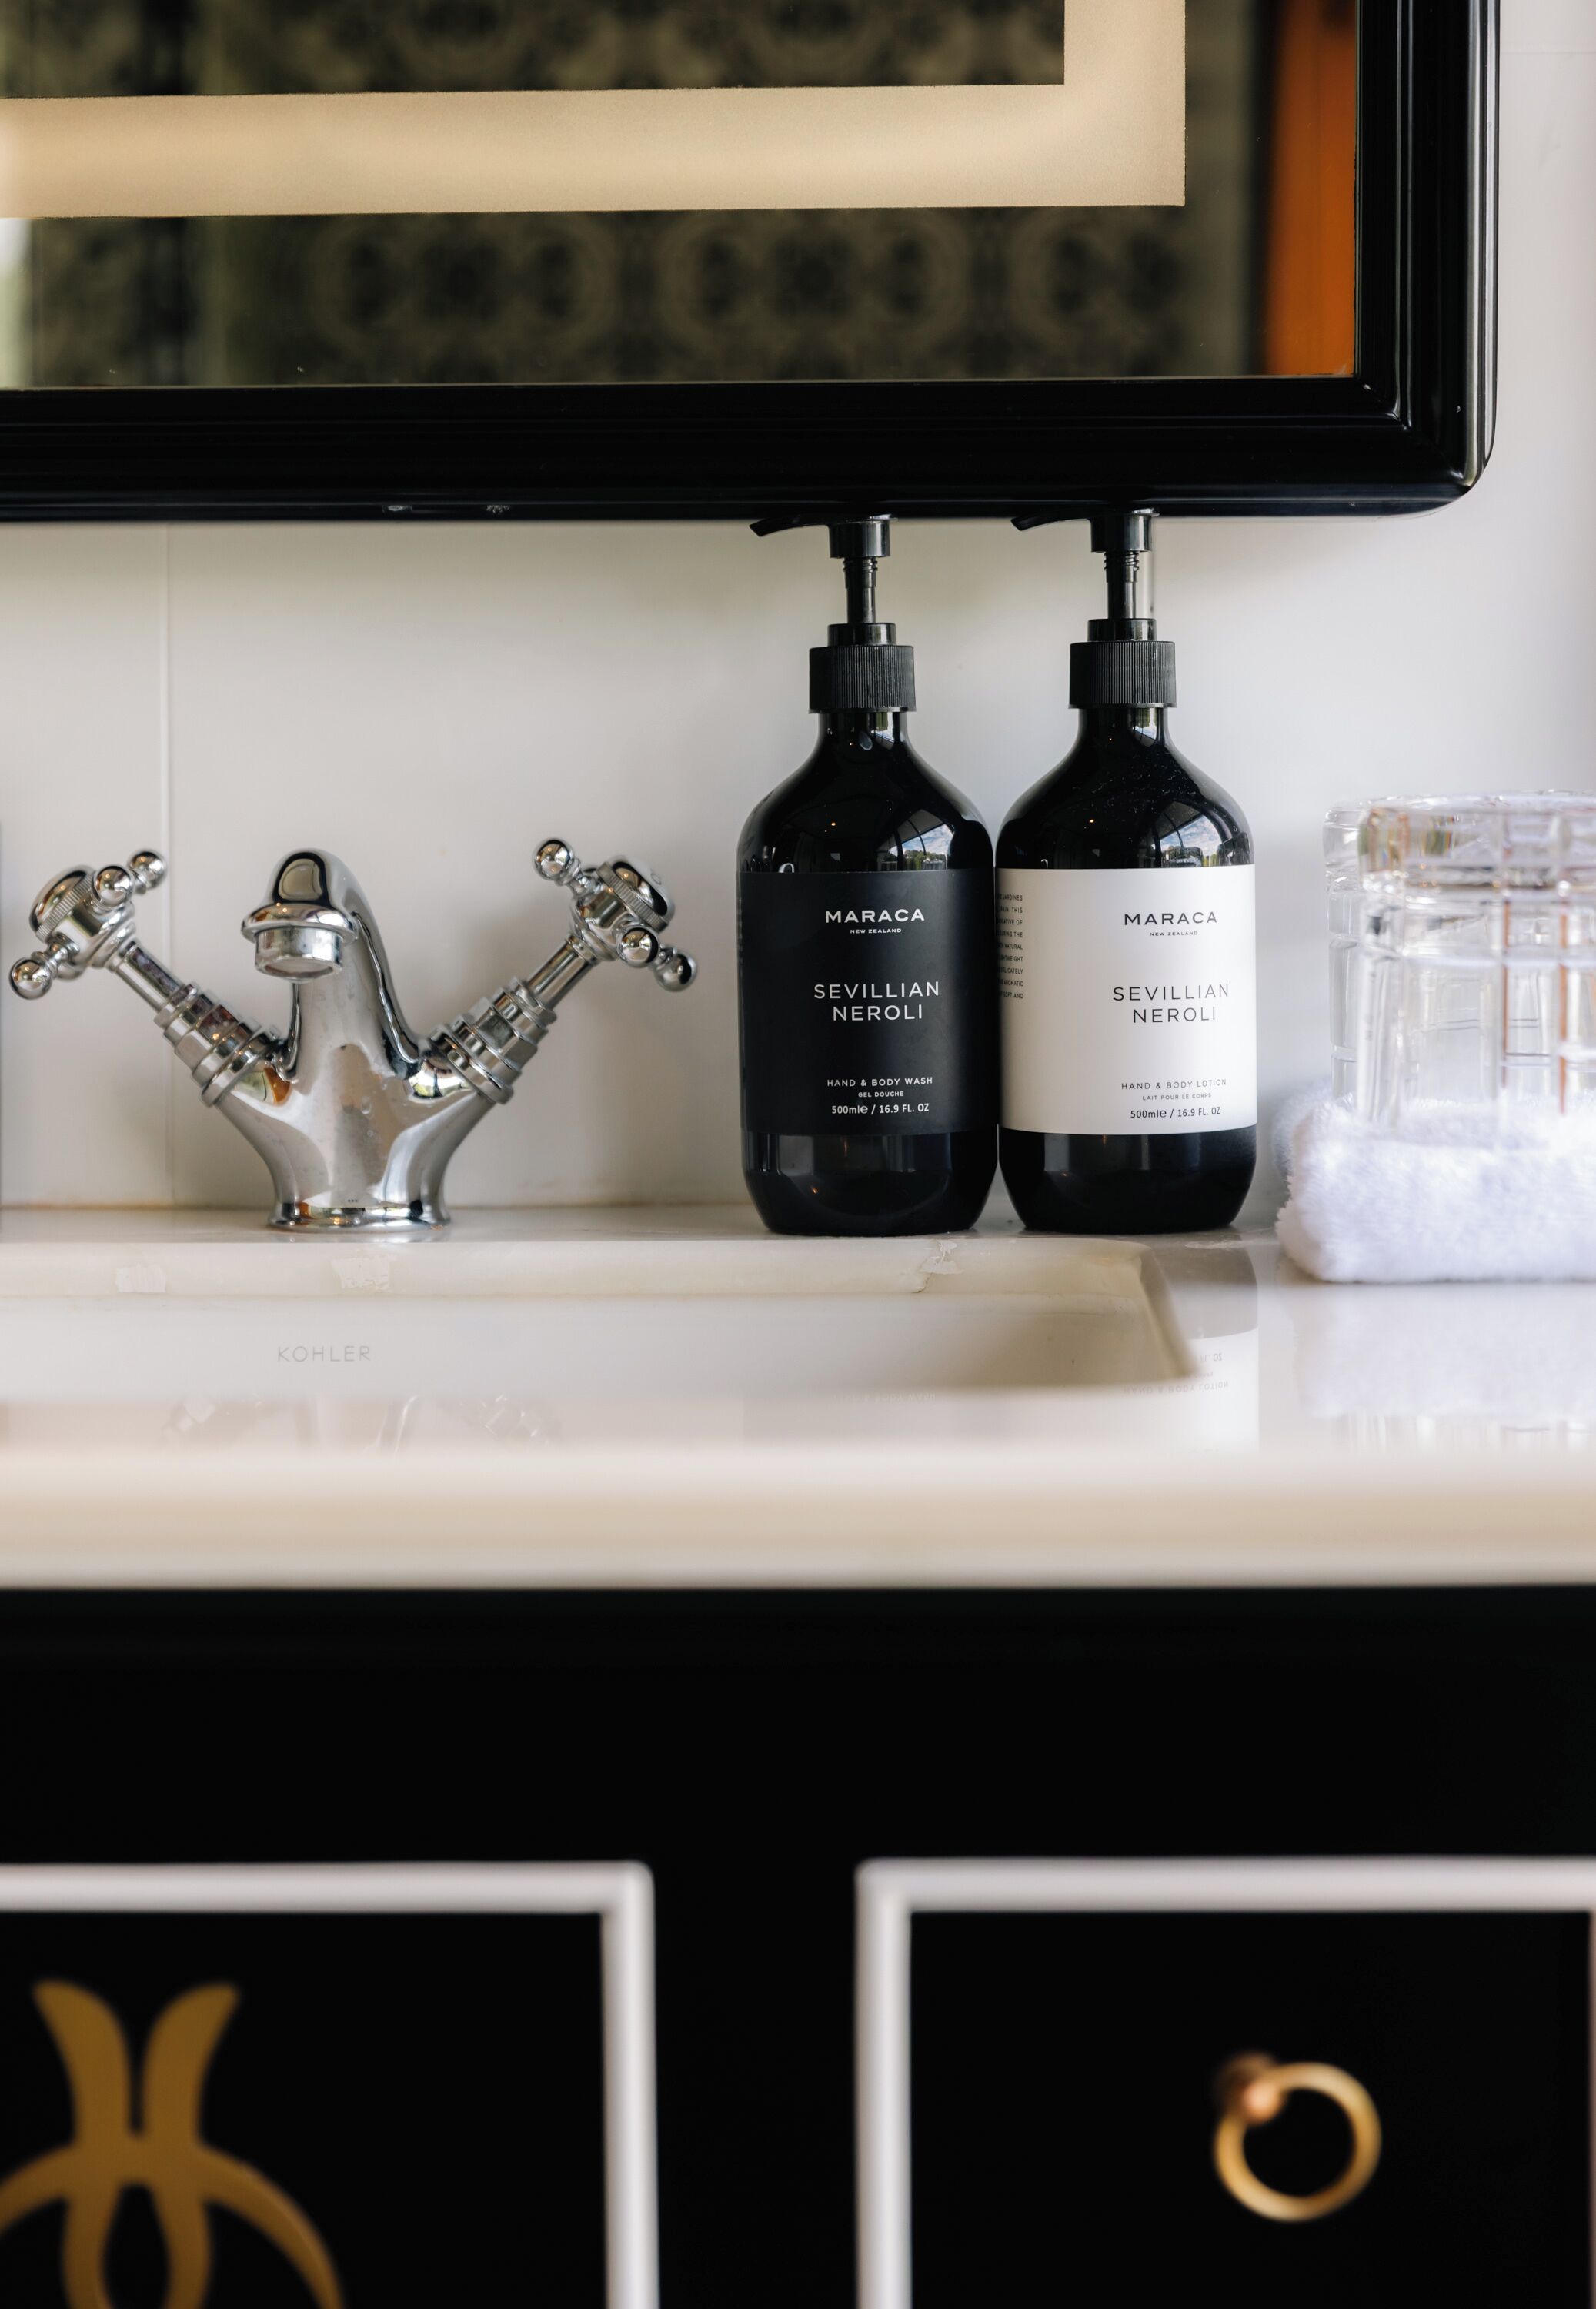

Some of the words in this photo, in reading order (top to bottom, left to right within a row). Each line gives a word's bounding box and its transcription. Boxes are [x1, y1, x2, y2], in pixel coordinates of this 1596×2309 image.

[825, 908, 925, 924] MARACA
[1124, 911, 1217, 926] MARACA
[814, 981, 939, 999] SEVILLIAN
[1113, 983, 1229, 1001] SEVILLIAN
[833, 1004, 922, 1021] NEROLI
[1133, 1006, 1215, 1024] NEROLI
[905, 1077, 933, 1085] WASH
[1166, 1081, 1193, 1089] BODY
[1197, 1079, 1227, 1088] LOTION
[870, 1104, 876, 1115] /
[879, 1104, 900, 1114] 16.9
[902, 1104, 915, 1112] FL.
[917, 1102, 930, 1111] OZ
[1170, 1108, 1174, 1119] /
[1177, 1108, 1195, 1118] 16.9
[1198, 1107, 1209, 1116] FL.
[1211, 1106, 1221, 1115] OZ
[277, 1345, 371, 1362] KOHLER
